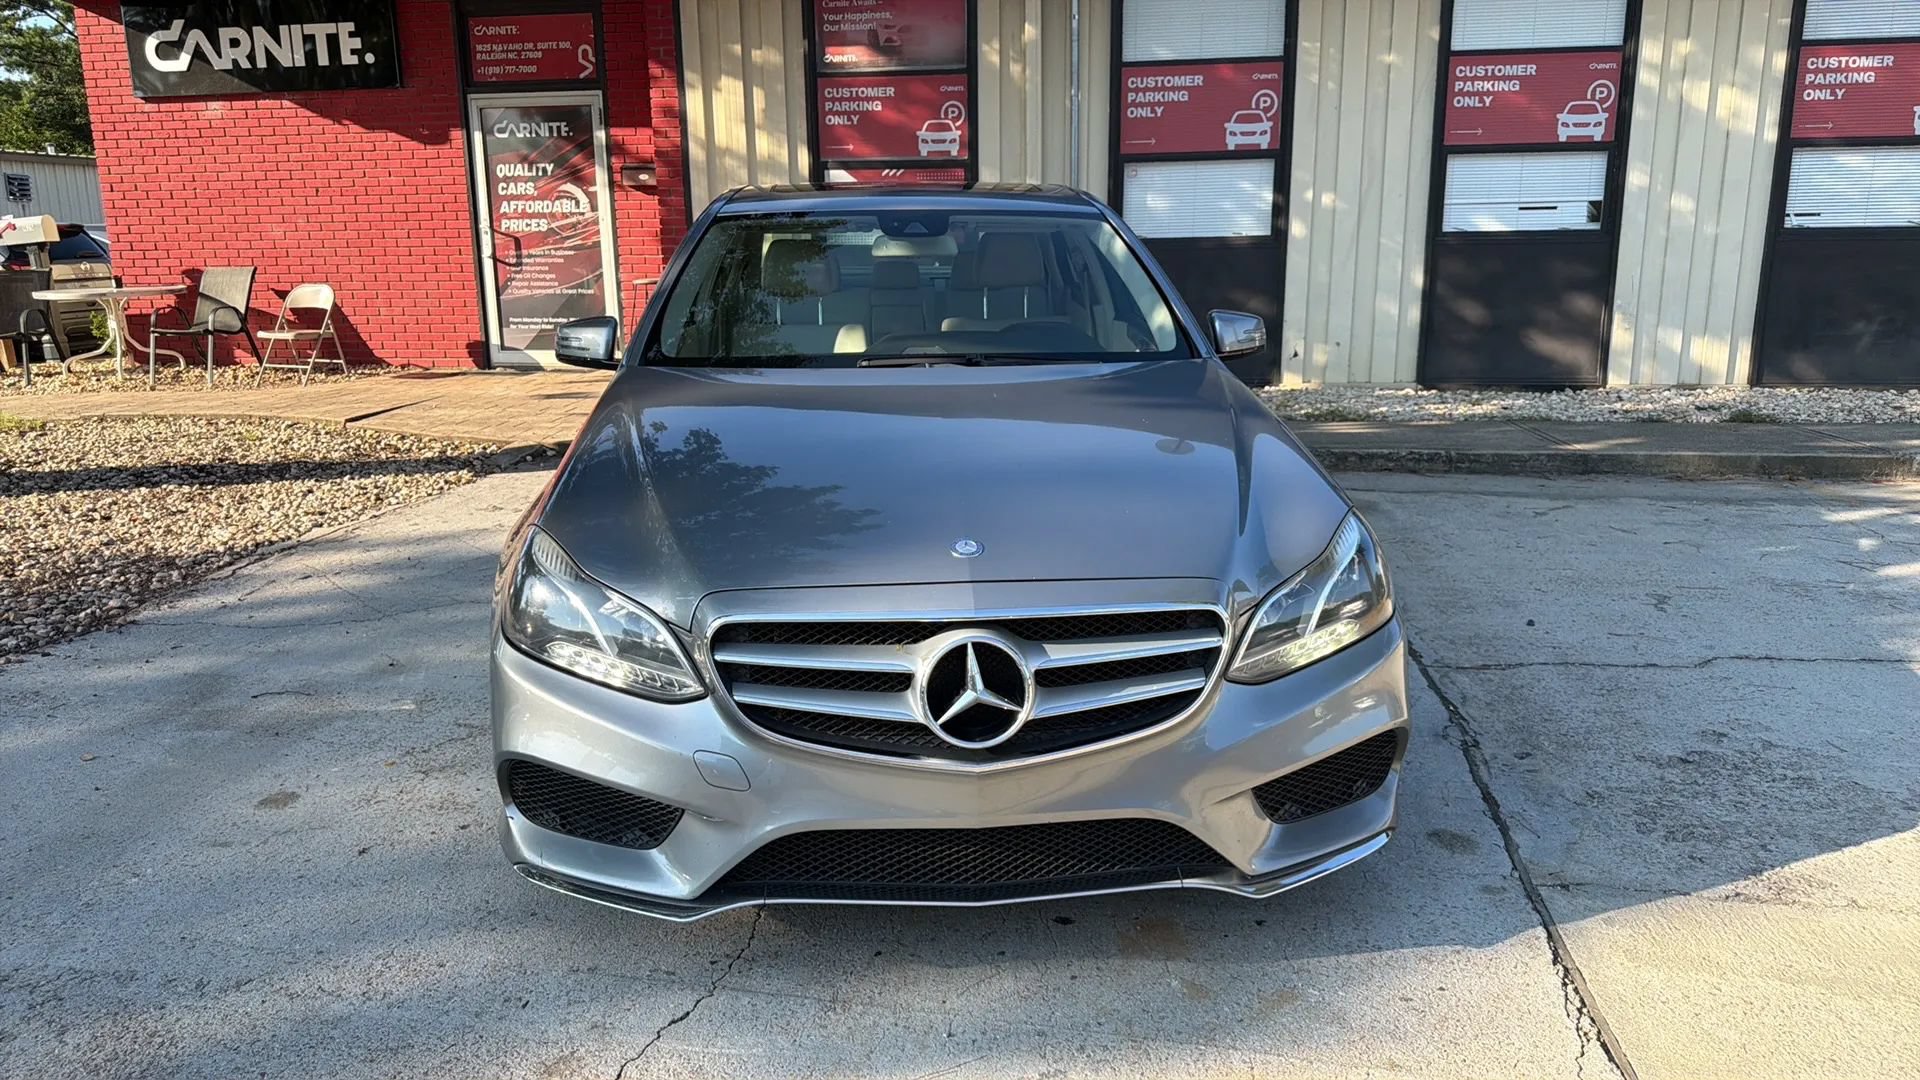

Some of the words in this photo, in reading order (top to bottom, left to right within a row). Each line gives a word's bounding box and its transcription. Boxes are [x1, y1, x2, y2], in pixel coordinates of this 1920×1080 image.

[823, 13, 843, 21] Your
[844, 11, 893, 21] Happiness,
[823, 23, 839, 32] Our
[841, 22, 877, 31] Mission!
[492, 42, 523, 51] NAVAHO
[537, 41, 558, 50] SUITE
[476, 52, 508, 61] RALEIGH
[1806, 55, 1895, 69] CUSTOMER
[504, 65, 537, 73] 717-7000
[1455, 64, 1537, 77] CUSTOMER
[1127, 75, 1204, 88] CUSTOMER
[1804, 71, 1876, 85] PARKING
[1454, 80, 1520, 92] PARKING
[824, 87, 895, 98] CUSTOMER
[1127, 90, 1189, 103] PARKING
[1803, 88, 1846, 101] ONLY
[825, 100, 882, 112] PARKING
[1453, 95, 1493, 107] ONLY
[1127, 106, 1164, 118] ONLY
[825, 114, 860, 125] ONLY
[496, 163, 554, 178] QUALITY
[498, 182, 538, 196] CARS,
[500, 200, 590, 214] AFFORDABLE
[501, 218, 549, 232] PRICES
